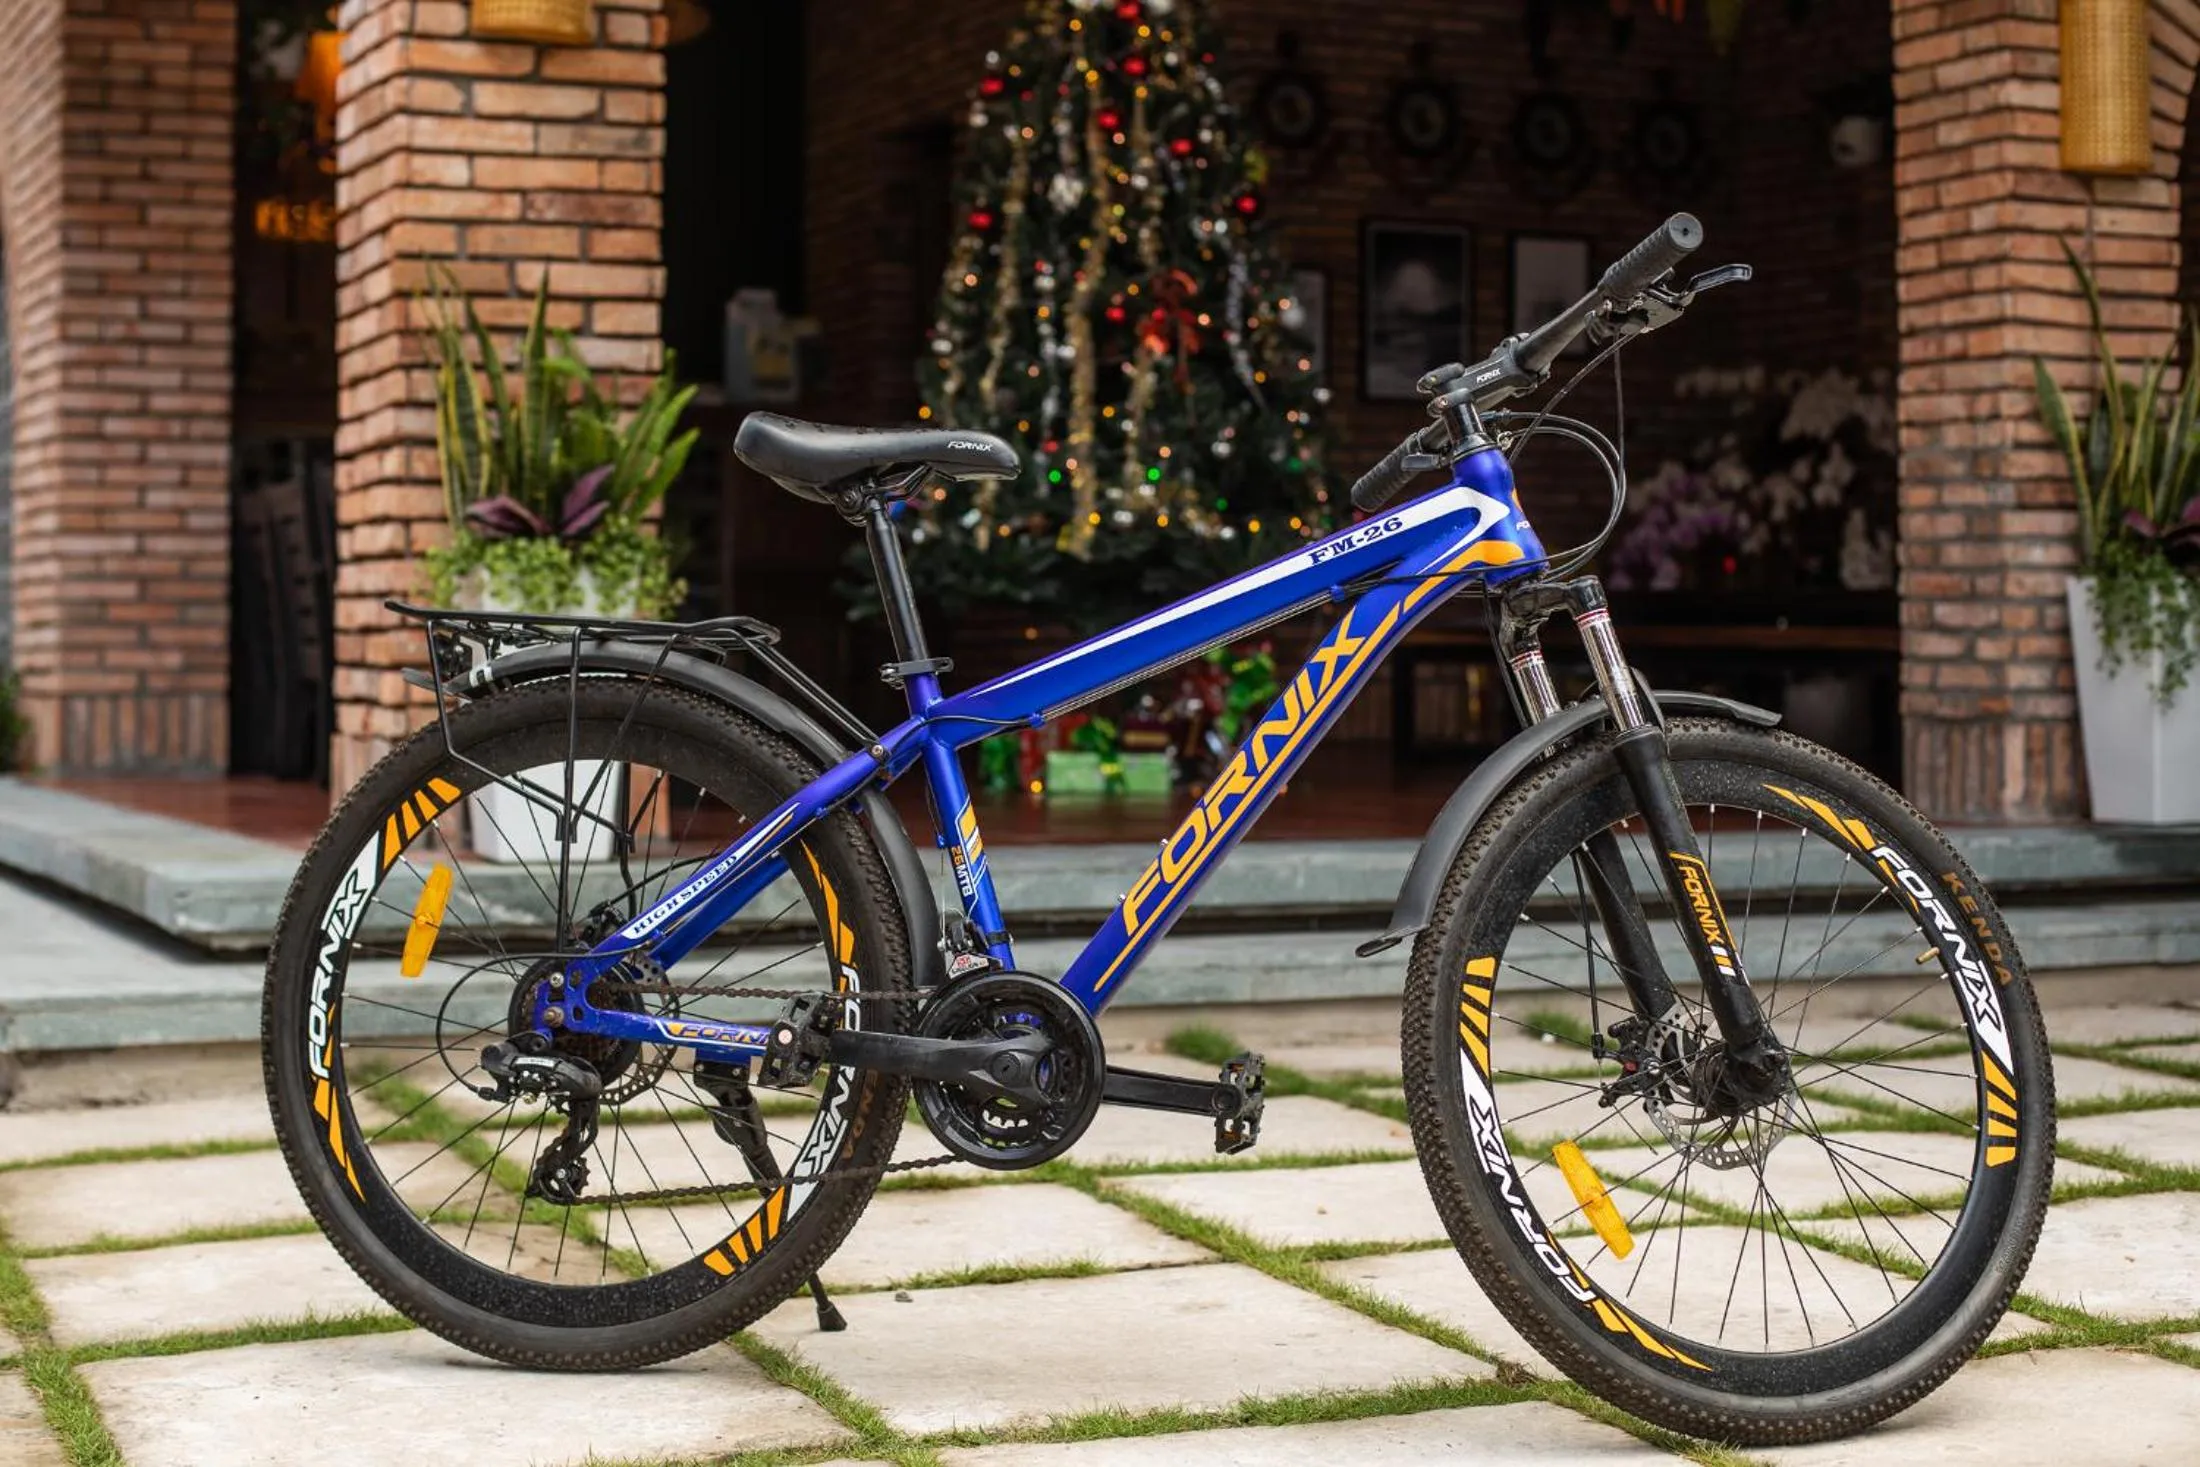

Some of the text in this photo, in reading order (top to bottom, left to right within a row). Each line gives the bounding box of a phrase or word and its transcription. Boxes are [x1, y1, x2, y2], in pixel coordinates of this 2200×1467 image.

[1308, 517, 1403, 565] FM-26
[1123, 606, 1366, 936] FORNIX
[309, 868, 367, 1078] FORNIX
[634, 855, 737, 933] HIGH SPEED
[1679, 866, 1724, 944] FORNIX
[1872, 846, 2001, 1032] FORNIX
[1941, 872, 2012, 986] KENDA
[803, 964, 861, 1175] FONIX
[1470, 1094, 1596, 1301] FORNIX
